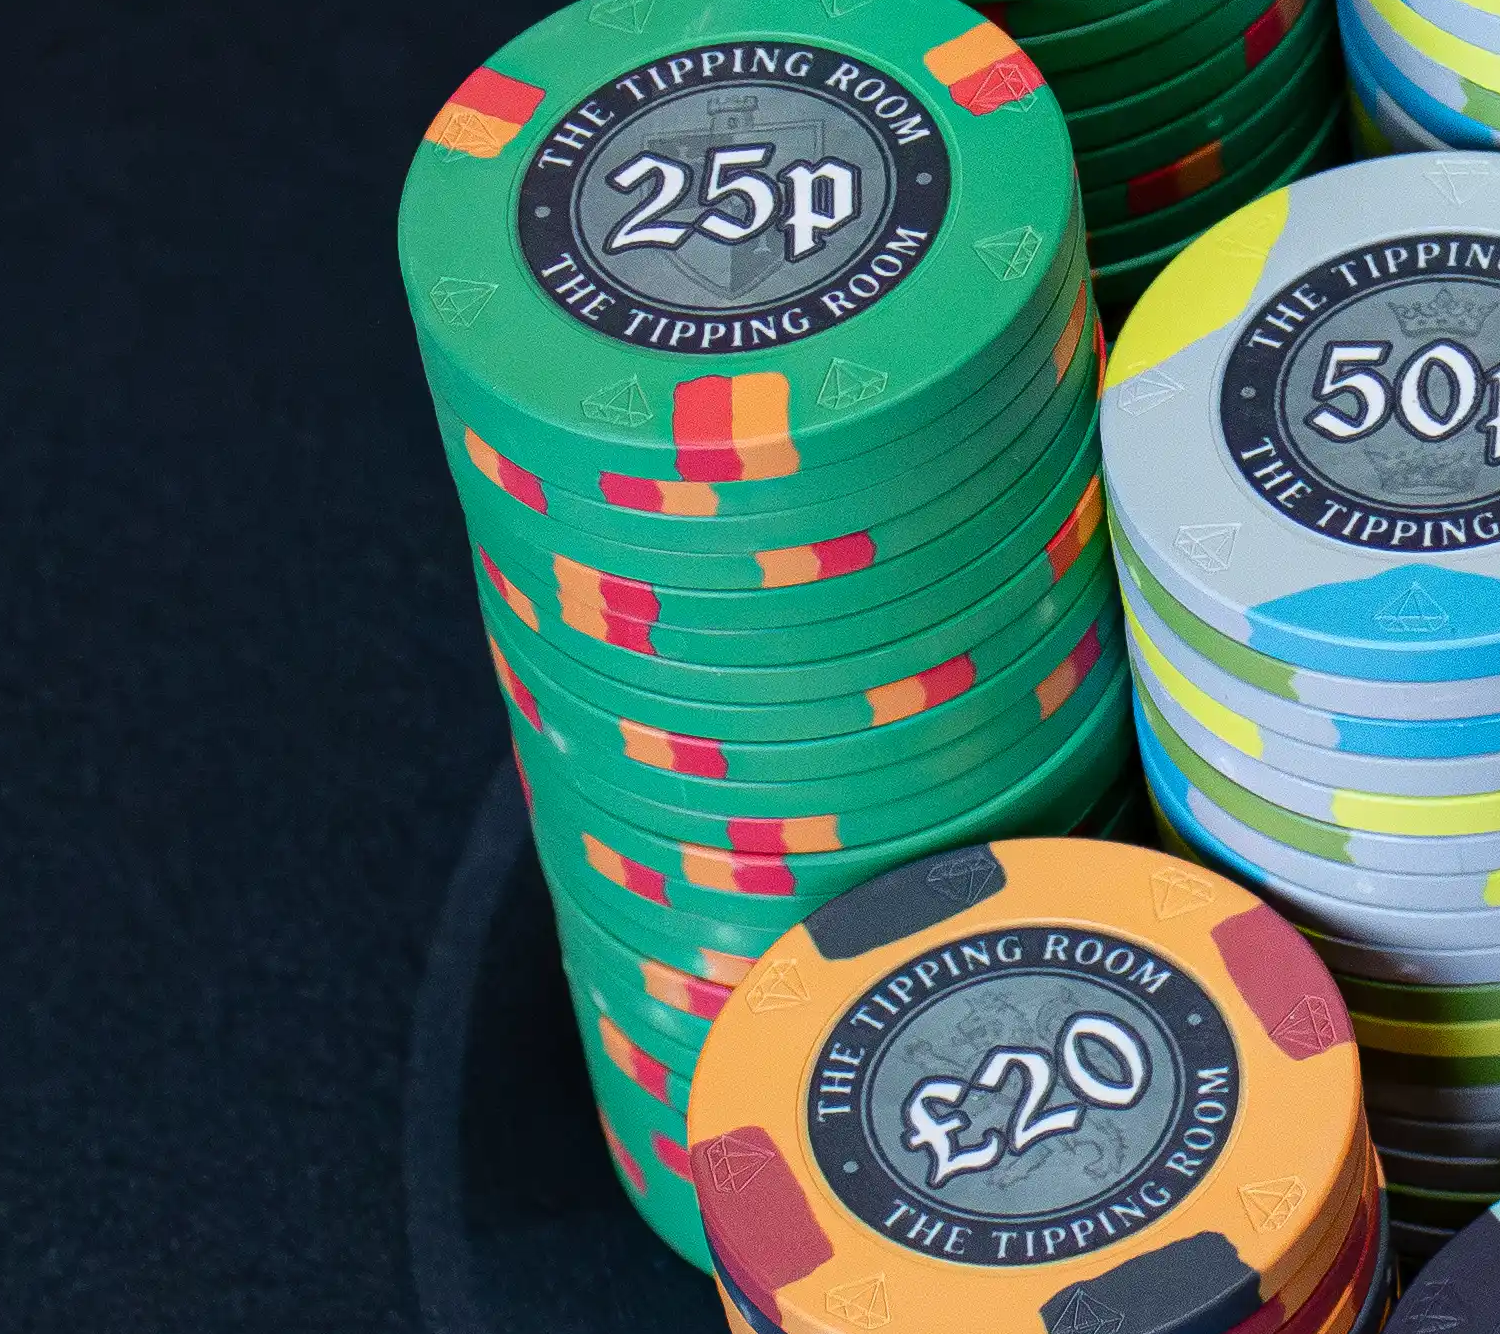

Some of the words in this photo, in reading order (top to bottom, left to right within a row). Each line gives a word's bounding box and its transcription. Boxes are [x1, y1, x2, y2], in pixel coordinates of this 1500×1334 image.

[538, 101, 616, 171] THE
[616, 46, 814, 99] TIPPING
[827, 61, 931, 147] ROOM
[605, 143, 860, 262] 25p
[541, 252, 617, 321] THE
[626, 308, 810, 349] TIPPING
[820, 226, 929, 319] ROOM
[1248, 284, 1328, 354] THE
[1240, 436, 1313, 509] THE
[1322, 499, 1500, 547] TIPPING
[818, 1042, 866, 1122] THE
[850, 934, 1023, 1033] TIPPING
[1043, 934, 1172, 995] ROOM
[901, 1011, 1151, 1187] £20
[881, 1198, 973, 1255] THE
[991, 1180, 1173, 1260] TIPPING
[1164, 1066, 1229, 1178] ROOM
